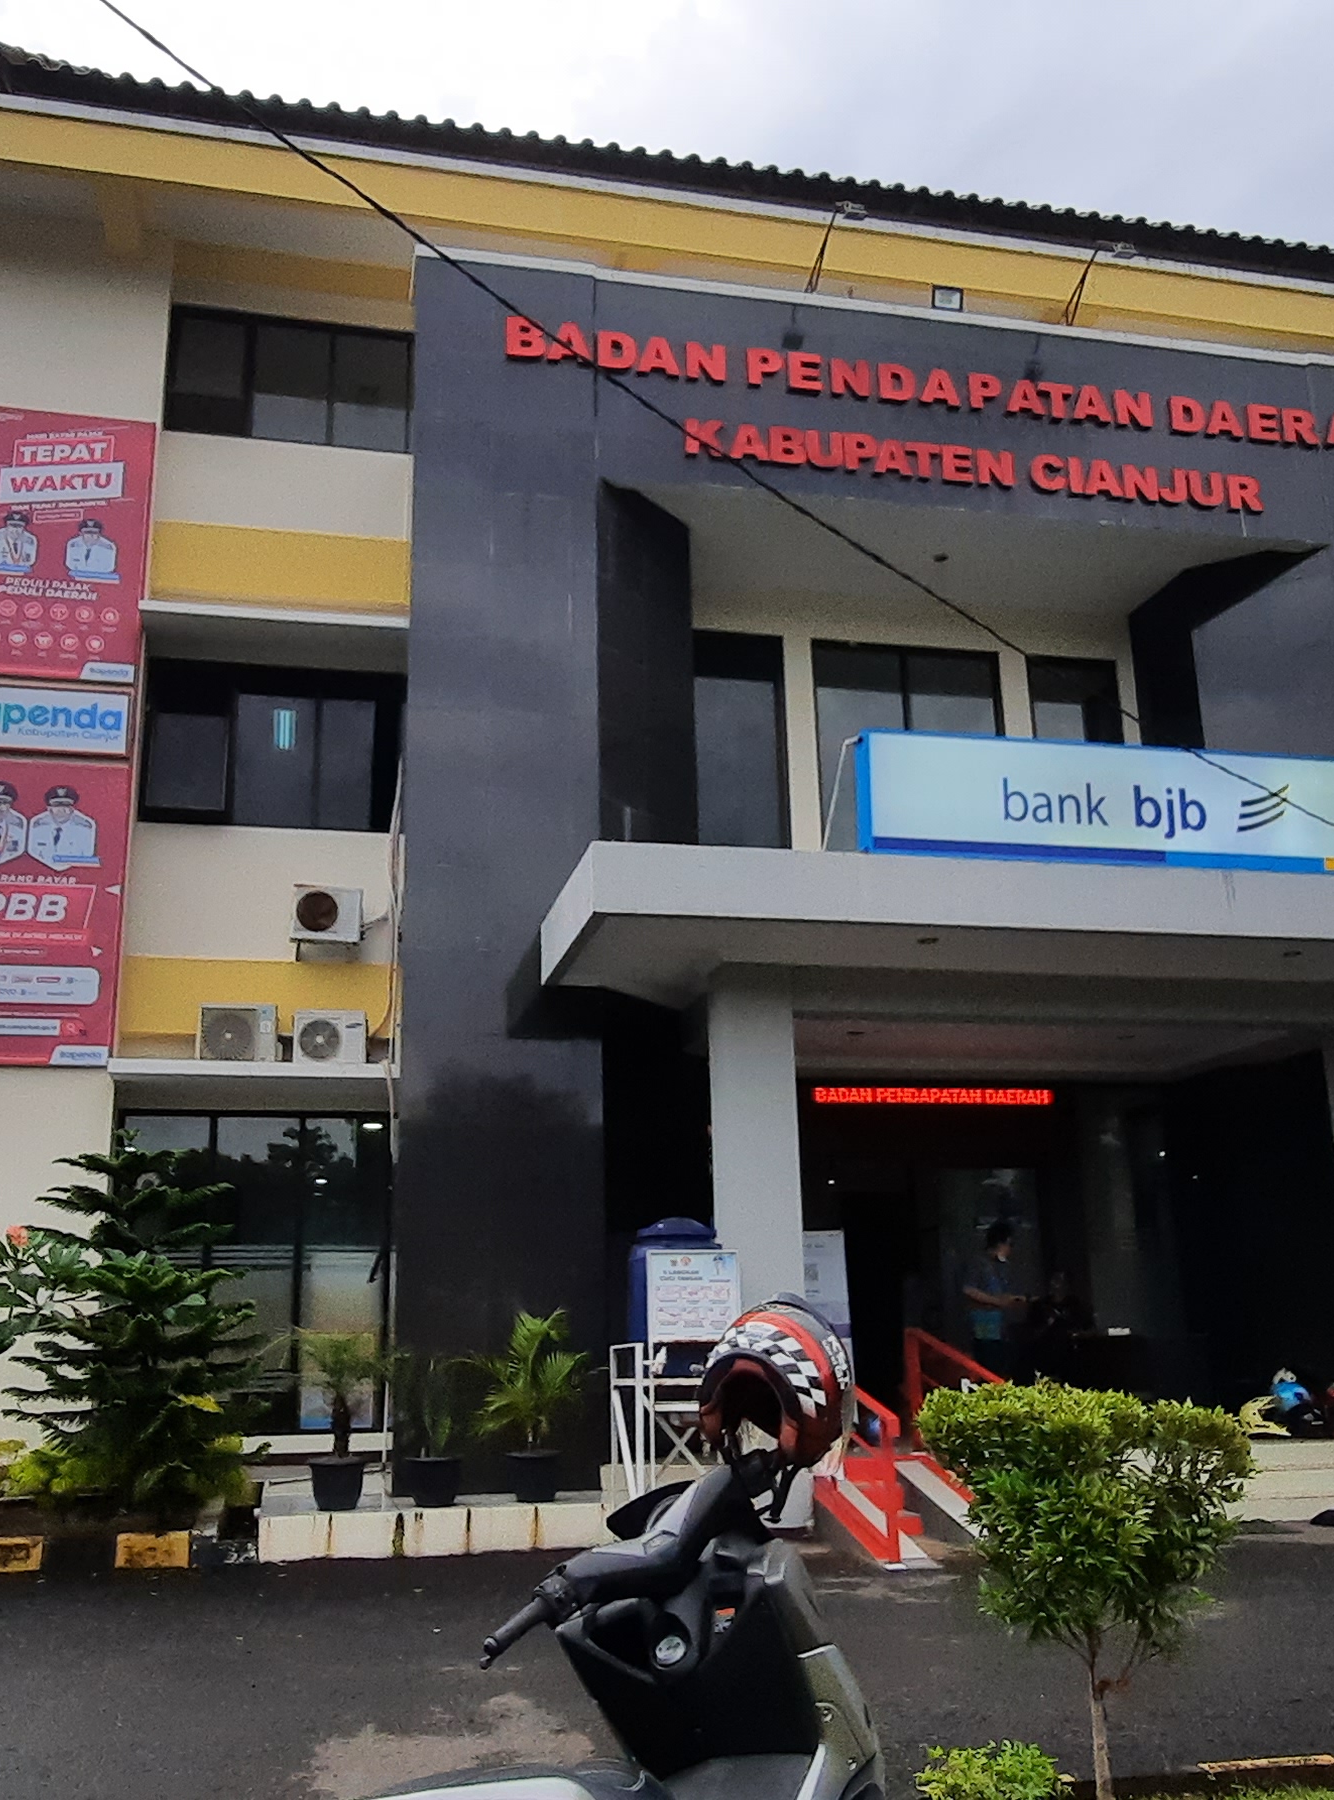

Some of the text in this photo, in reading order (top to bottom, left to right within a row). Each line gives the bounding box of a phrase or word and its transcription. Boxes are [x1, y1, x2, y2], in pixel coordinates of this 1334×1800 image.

[505, 315, 728, 384] BADAN
[746, 346, 1154, 429] PENDAPATAN
[19, 442, 108, 463] TEPAT
[683, 417, 1264, 512] KABUPATEN CIANJUR
[10, 472, 113, 494] WAKTU
[5, 576, 91, 591] PEDULI PAJAK
[45, 588, 98, 601] DAERAH
[17, 727, 122, 743] Kabupaten Cianjur
[1002, 776, 1208, 840] bank bjb
[36, 875, 77, 884] BAYAR
[814, 1087, 1050, 1105] BADAN PENDAPATAN DAERAH
